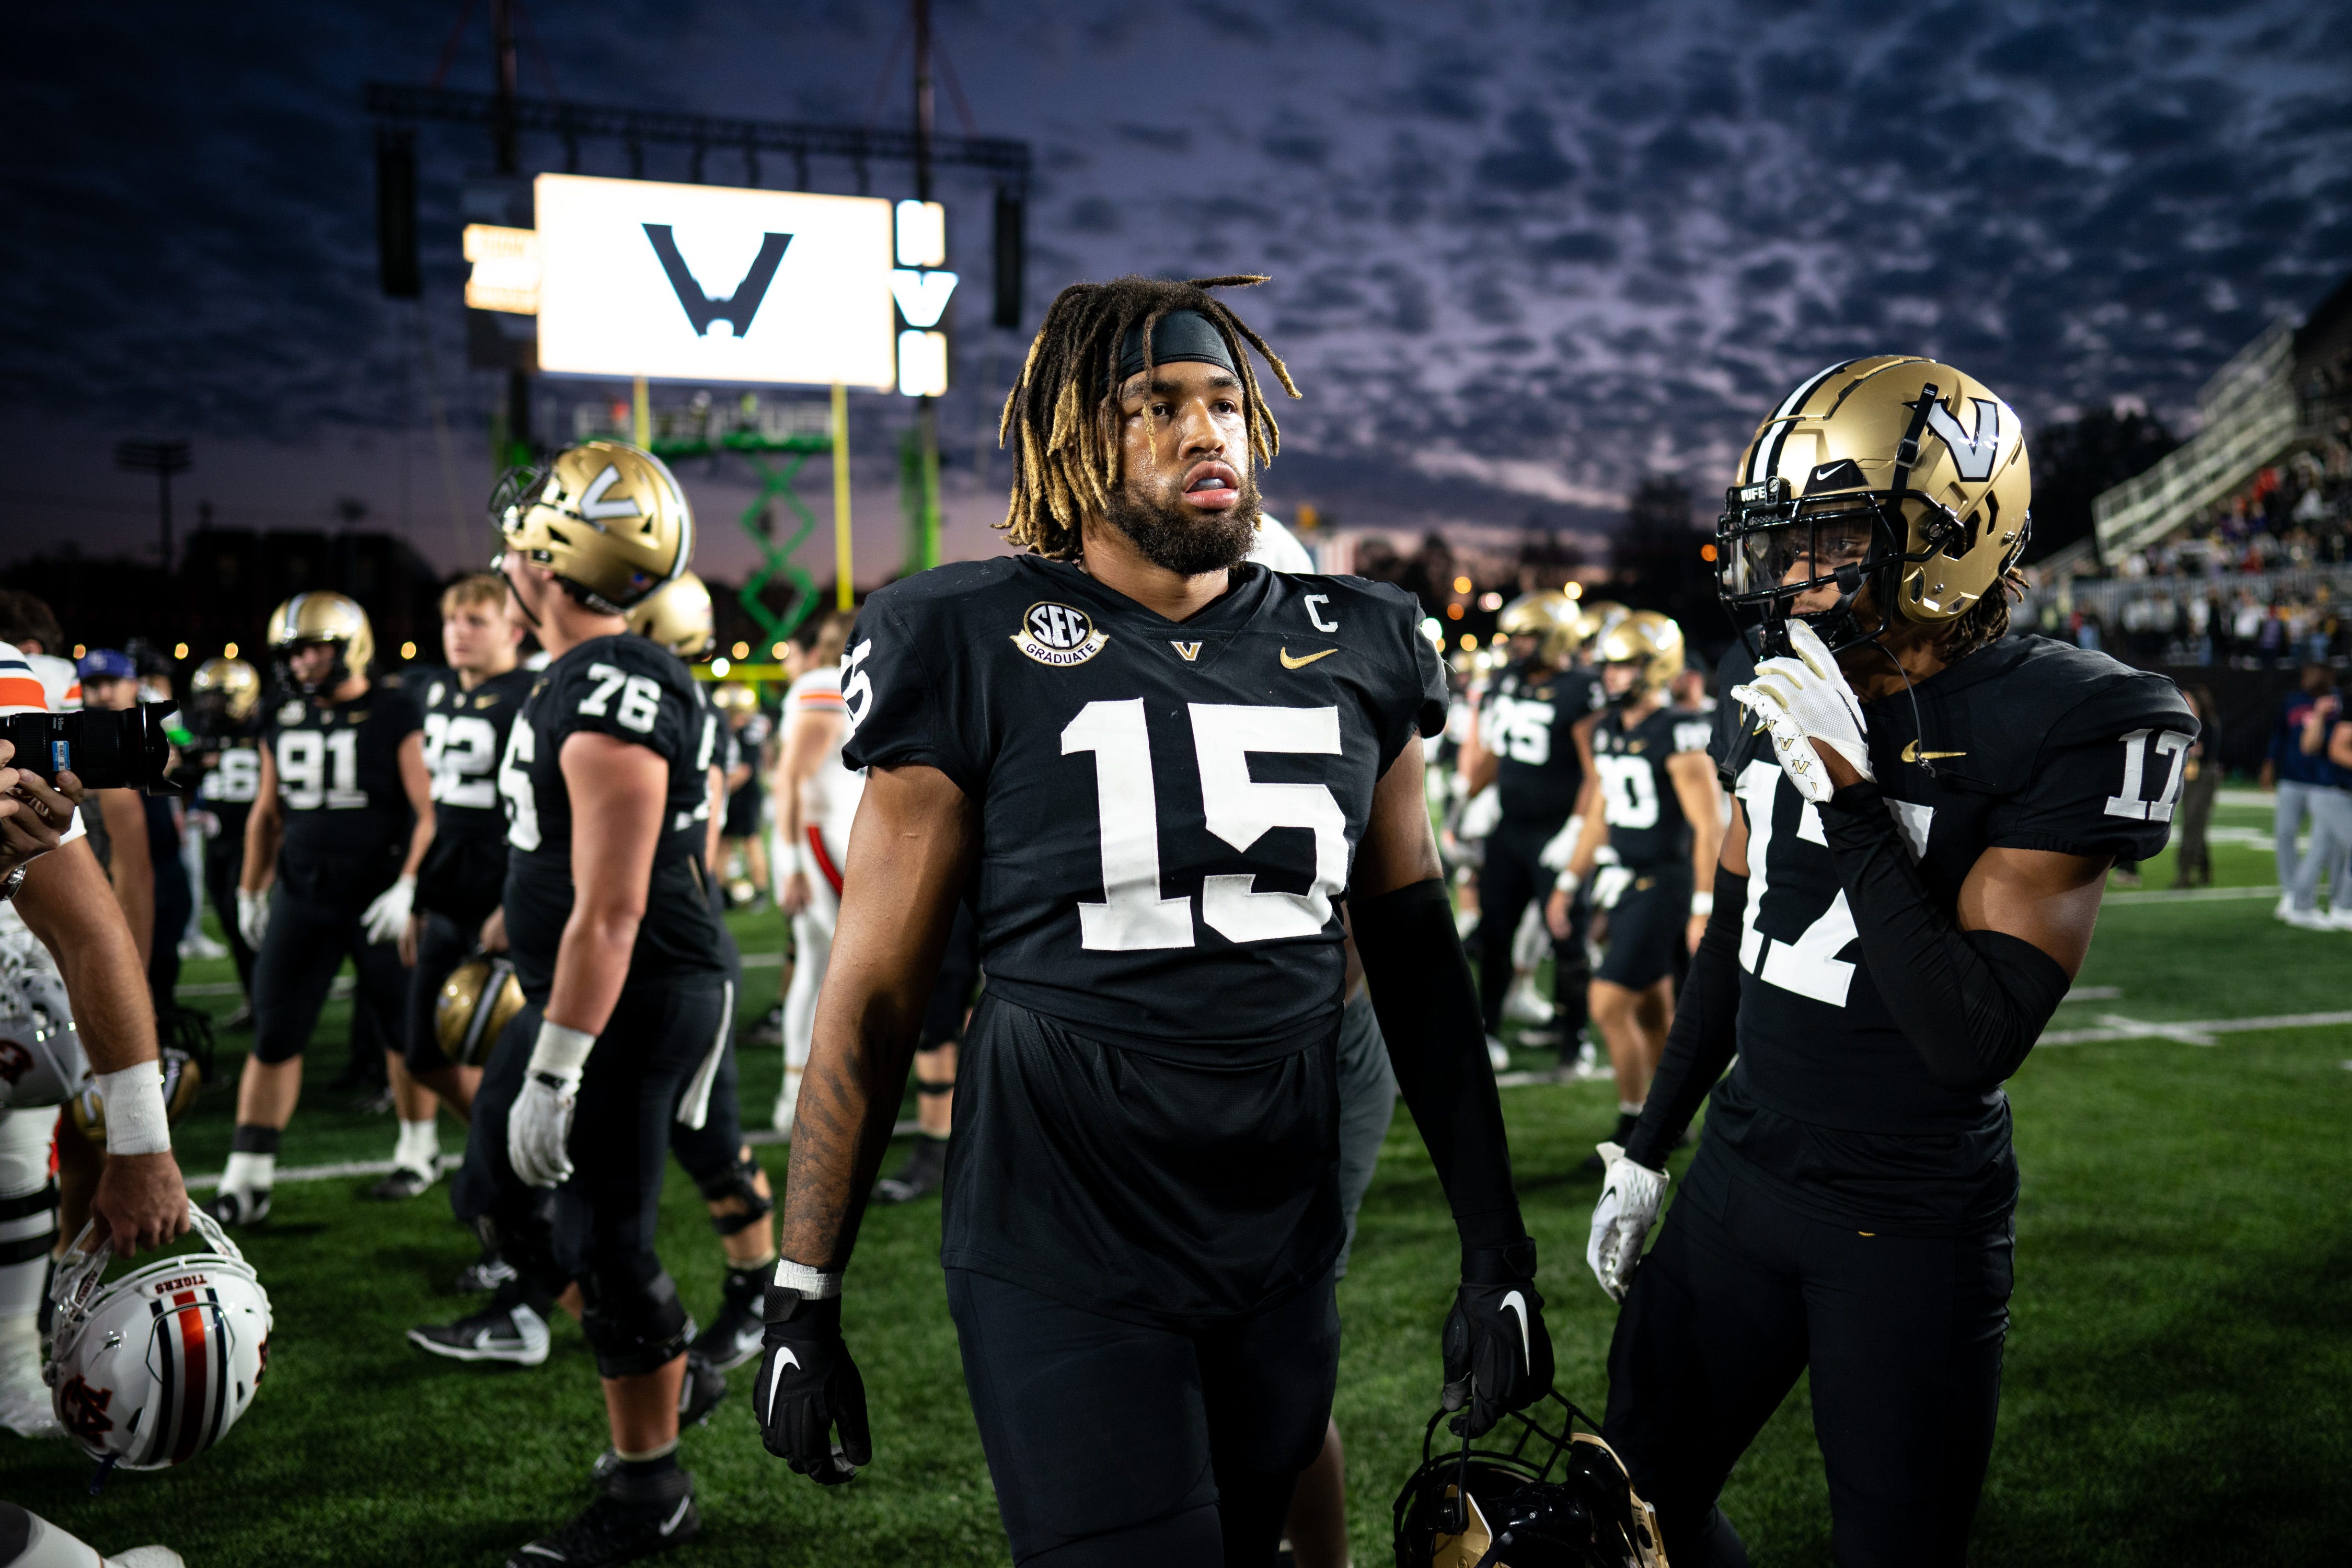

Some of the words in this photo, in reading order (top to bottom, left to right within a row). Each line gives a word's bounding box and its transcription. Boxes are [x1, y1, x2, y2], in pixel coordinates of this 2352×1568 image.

[1901, 396, 1999, 482] V
[1030, 605, 1086, 648] SEC
[1304, 594, 1338, 632] C
[1026, 643, 1097, 664] GRADUATE
[1170, 640, 1203, 661] V
[578, 663, 662, 733] 76
[276, 729, 368, 810] 91
[2104, 729, 2195, 822] 17
[1061, 697, 1349, 951] 15
[1735, 759, 1934, 1008] 17
[155, 1274, 207, 1294] TIGERS
